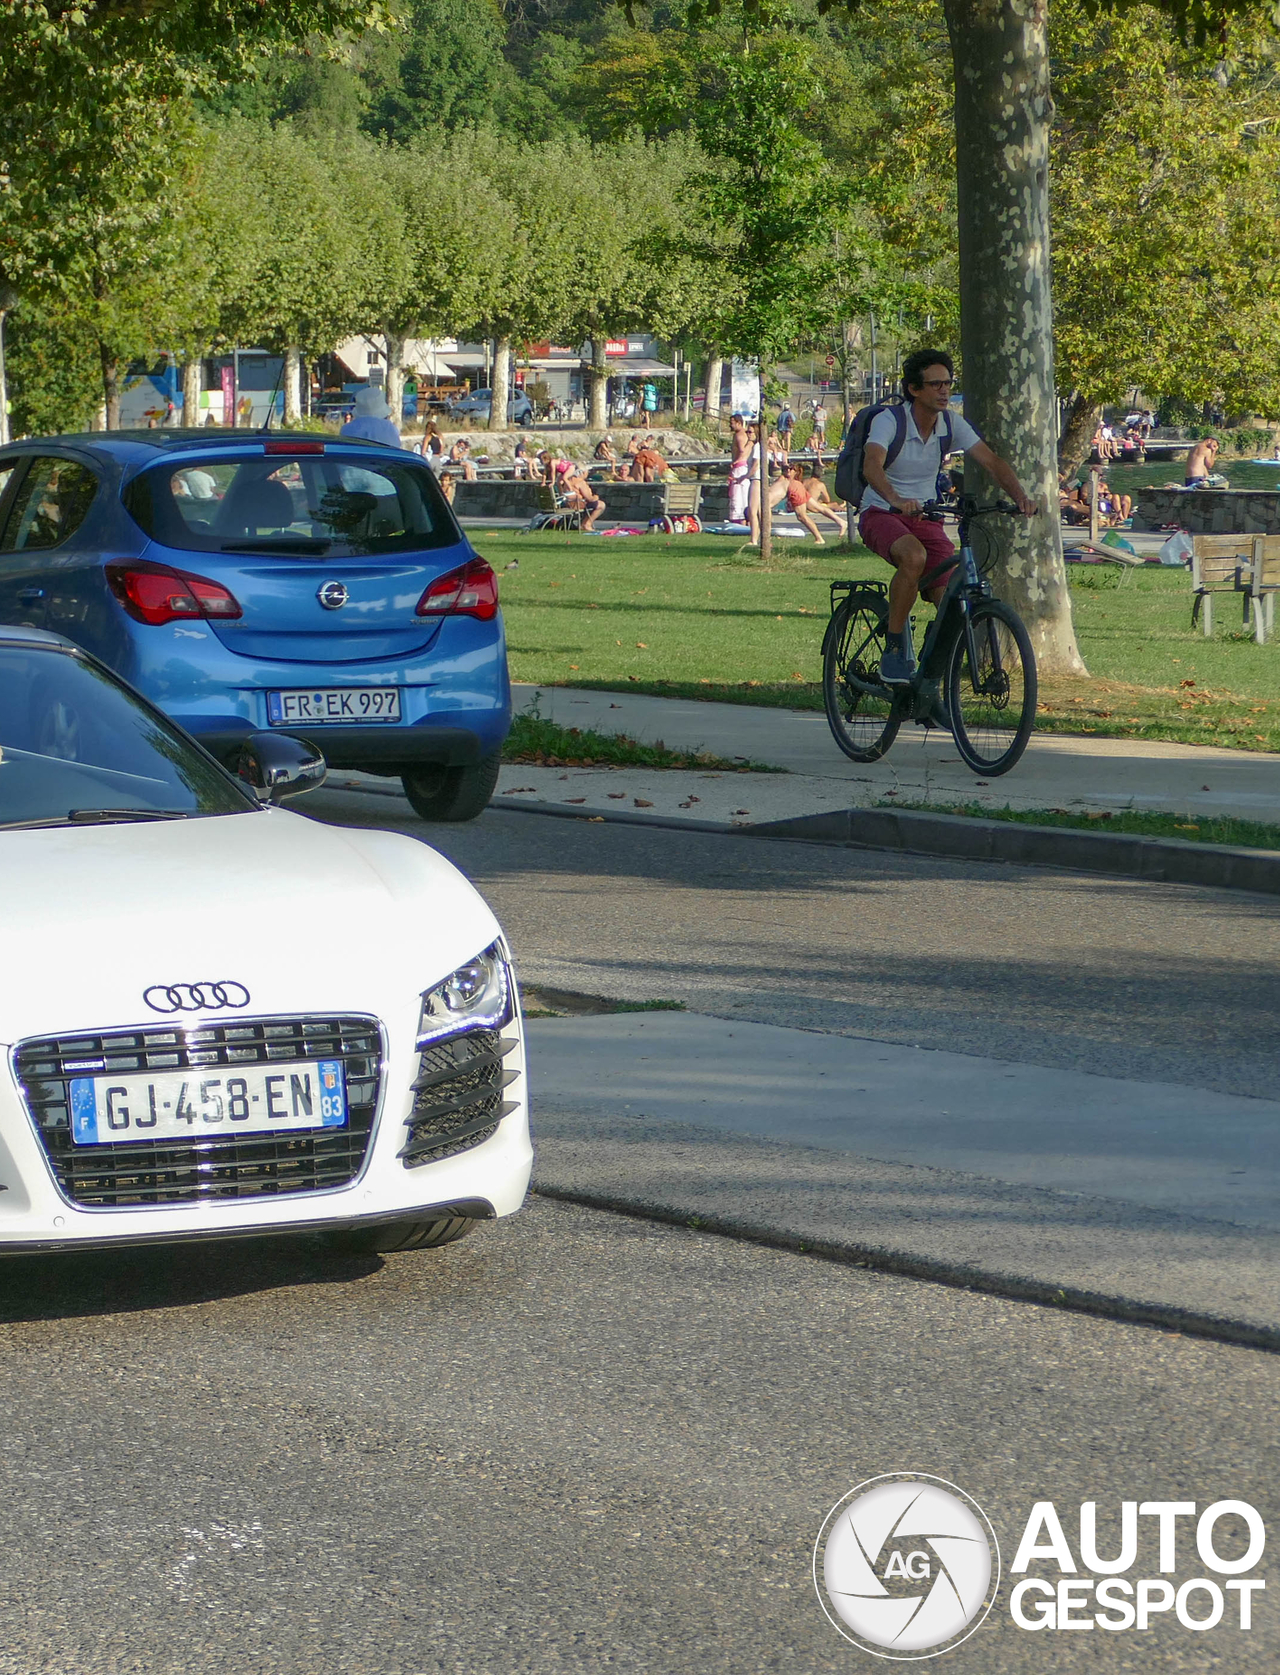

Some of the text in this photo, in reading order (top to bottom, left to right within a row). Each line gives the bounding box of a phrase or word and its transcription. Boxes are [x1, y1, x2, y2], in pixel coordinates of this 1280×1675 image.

[283, 692, 396, 717] FR EK 997
[106, 1073, 314, 1130] GJ-458-EN
[322, 1095, 343, 1118] 83
[80, 1117, 89, 1130] F
